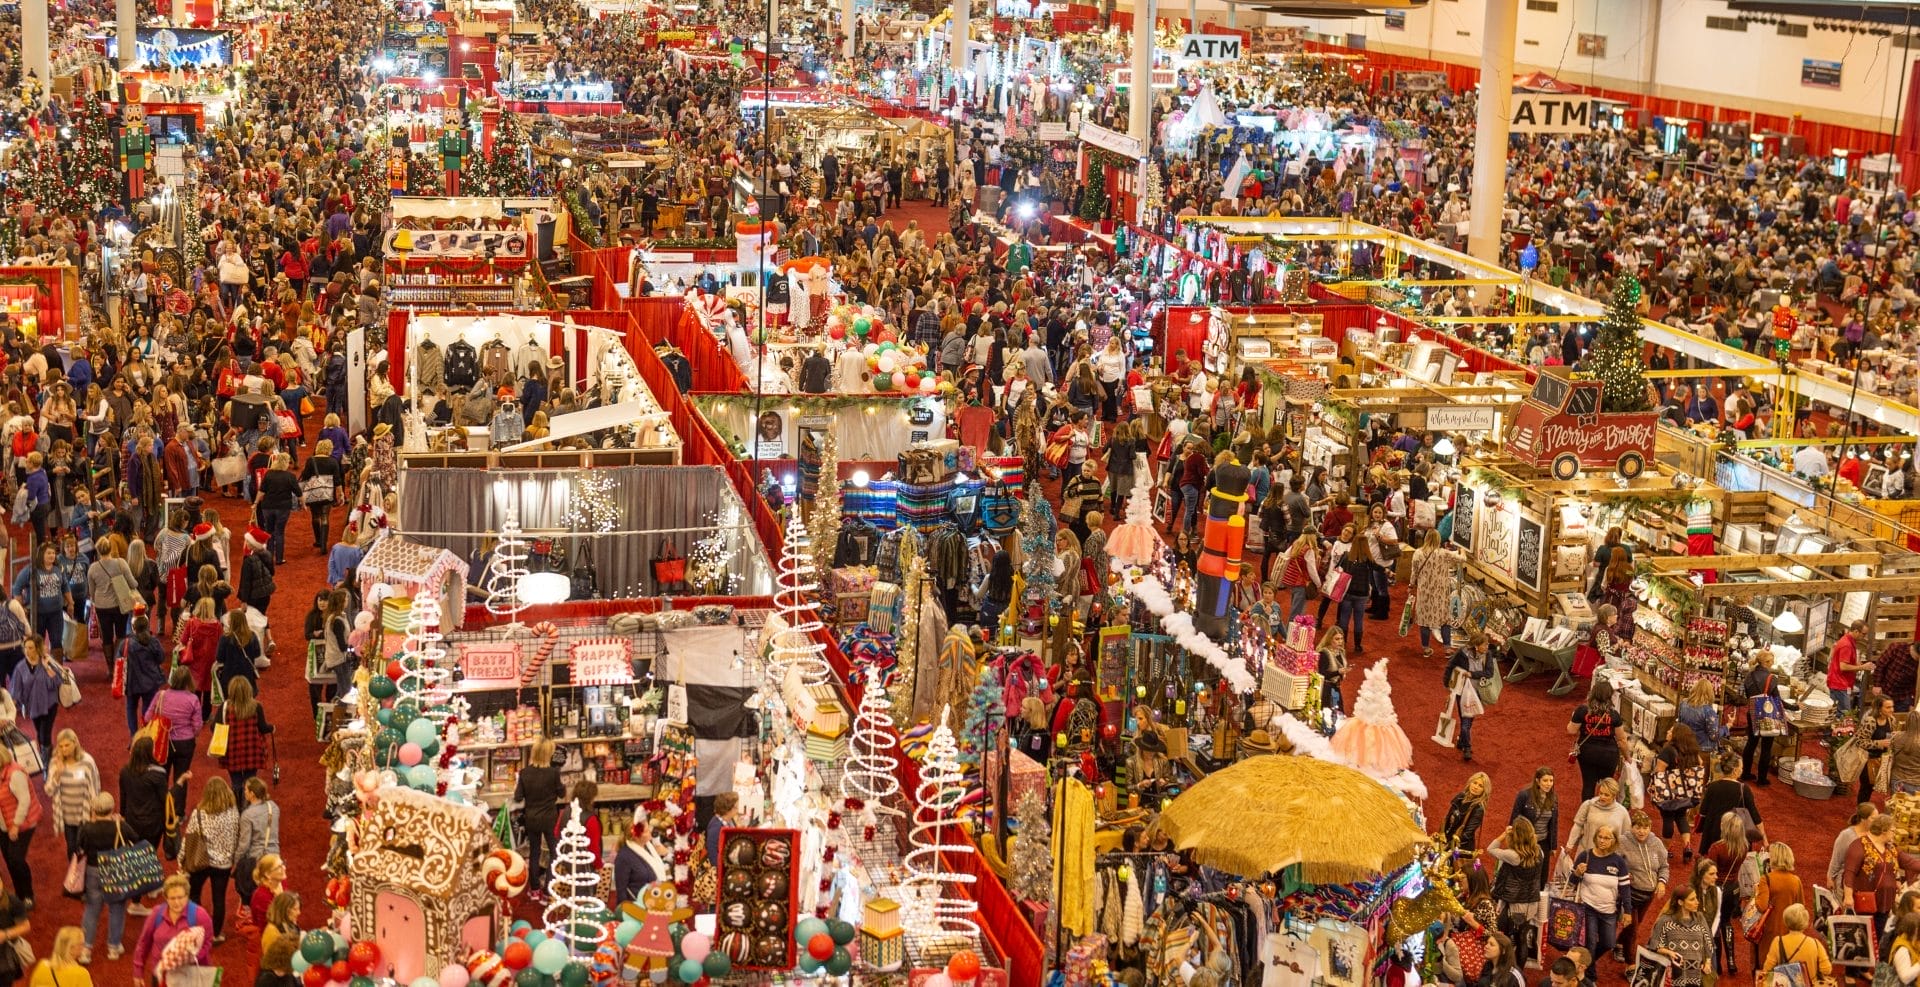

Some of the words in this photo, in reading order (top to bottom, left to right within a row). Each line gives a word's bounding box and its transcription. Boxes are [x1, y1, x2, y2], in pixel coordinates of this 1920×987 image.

[1185, 39, 1240, 58] ATM
[1512, 100, 1588, 126] ATM
[1546, 424, 1590, 453] Merry
[1604, 423, 1654, 450] Bright
[472, 655, 507, 665] BATH
[580, 649, 623, 662] HAPPY
[470, 666, 512, 677] TREATS
[583, 663, 620, 676] GIFTS
